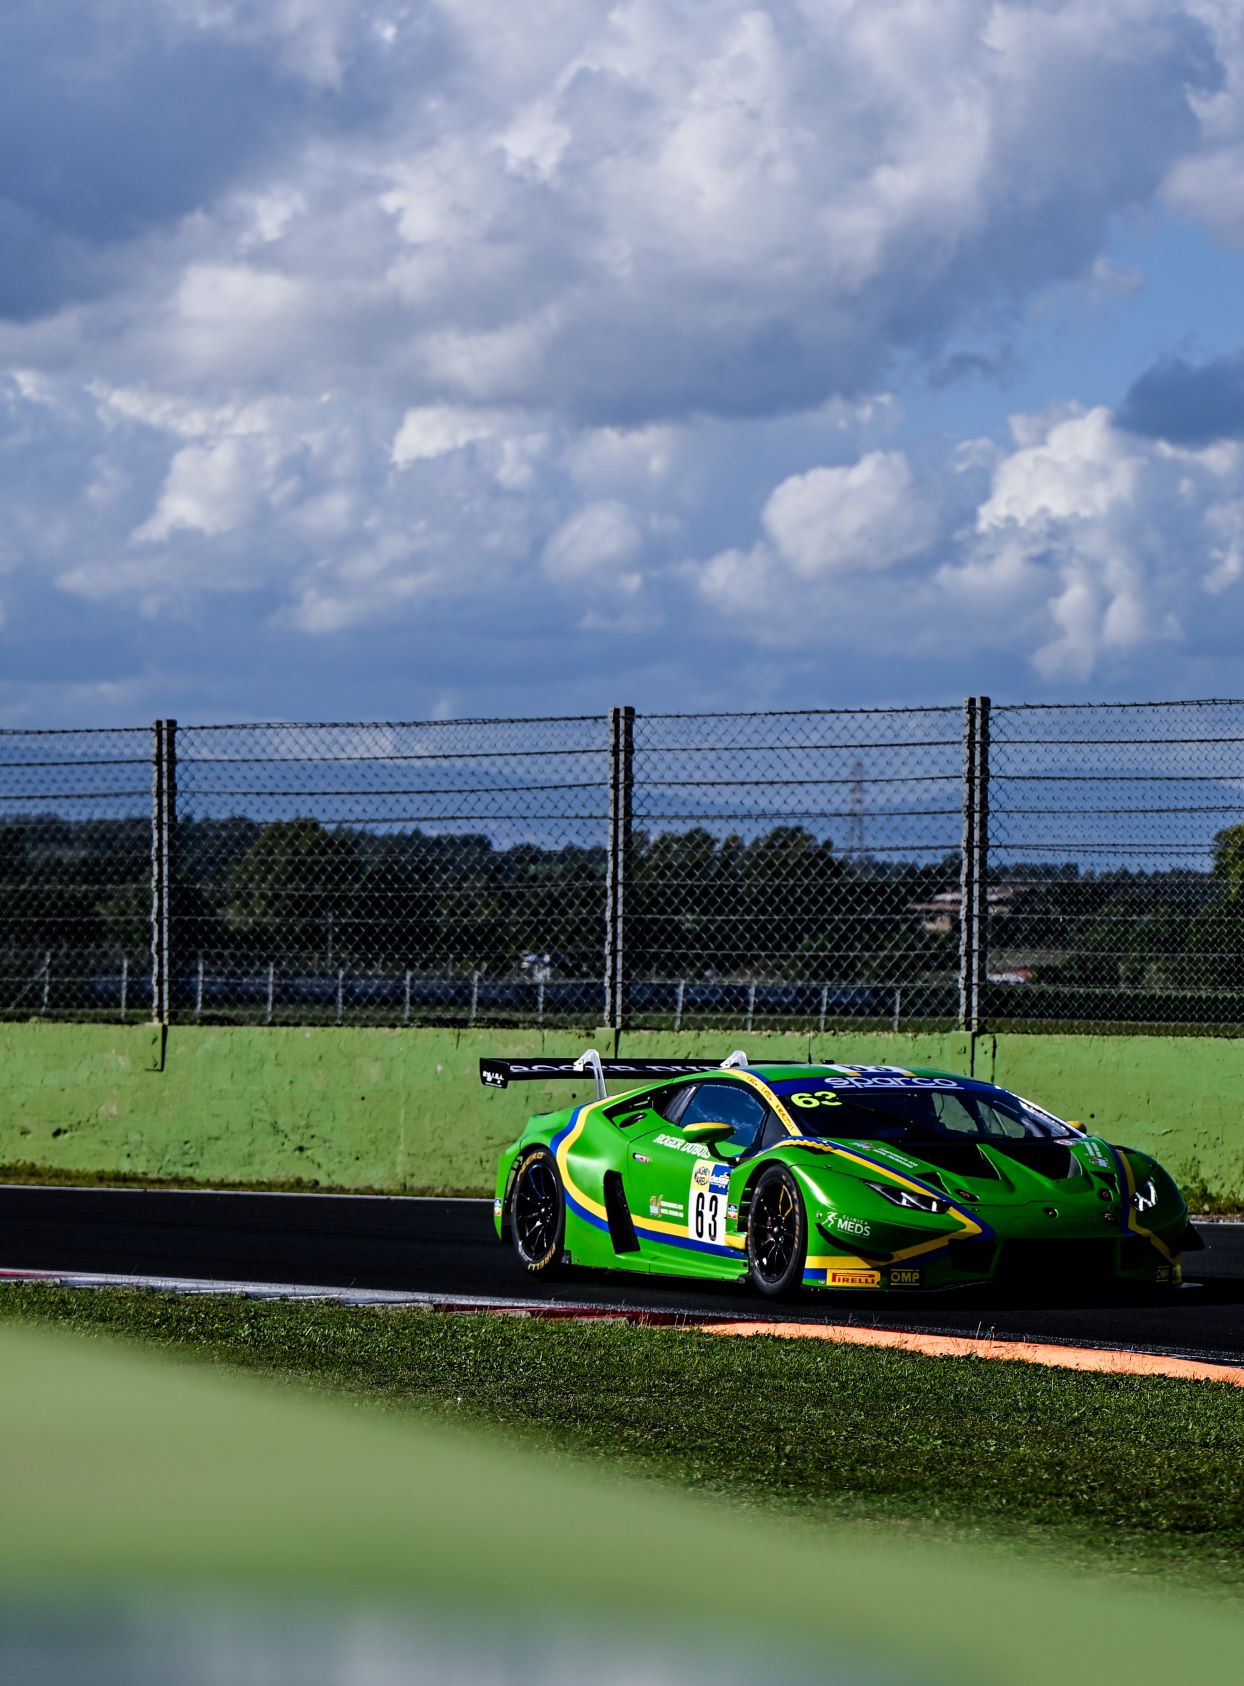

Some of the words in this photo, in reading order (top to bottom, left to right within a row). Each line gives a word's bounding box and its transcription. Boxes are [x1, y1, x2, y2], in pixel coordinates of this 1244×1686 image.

[824, 1077, 958, 1088] sparco
[790, 1091, 842, 1108] 63
[652, 1133, 686, 1150] ROGER
[696, 1192, 719, 1241] 63
[837, 1219, 871, 1237] MEDS
[831, 1272, 876, 1284] PIRELLI
[890, 1271, 920, 1284] OMP
